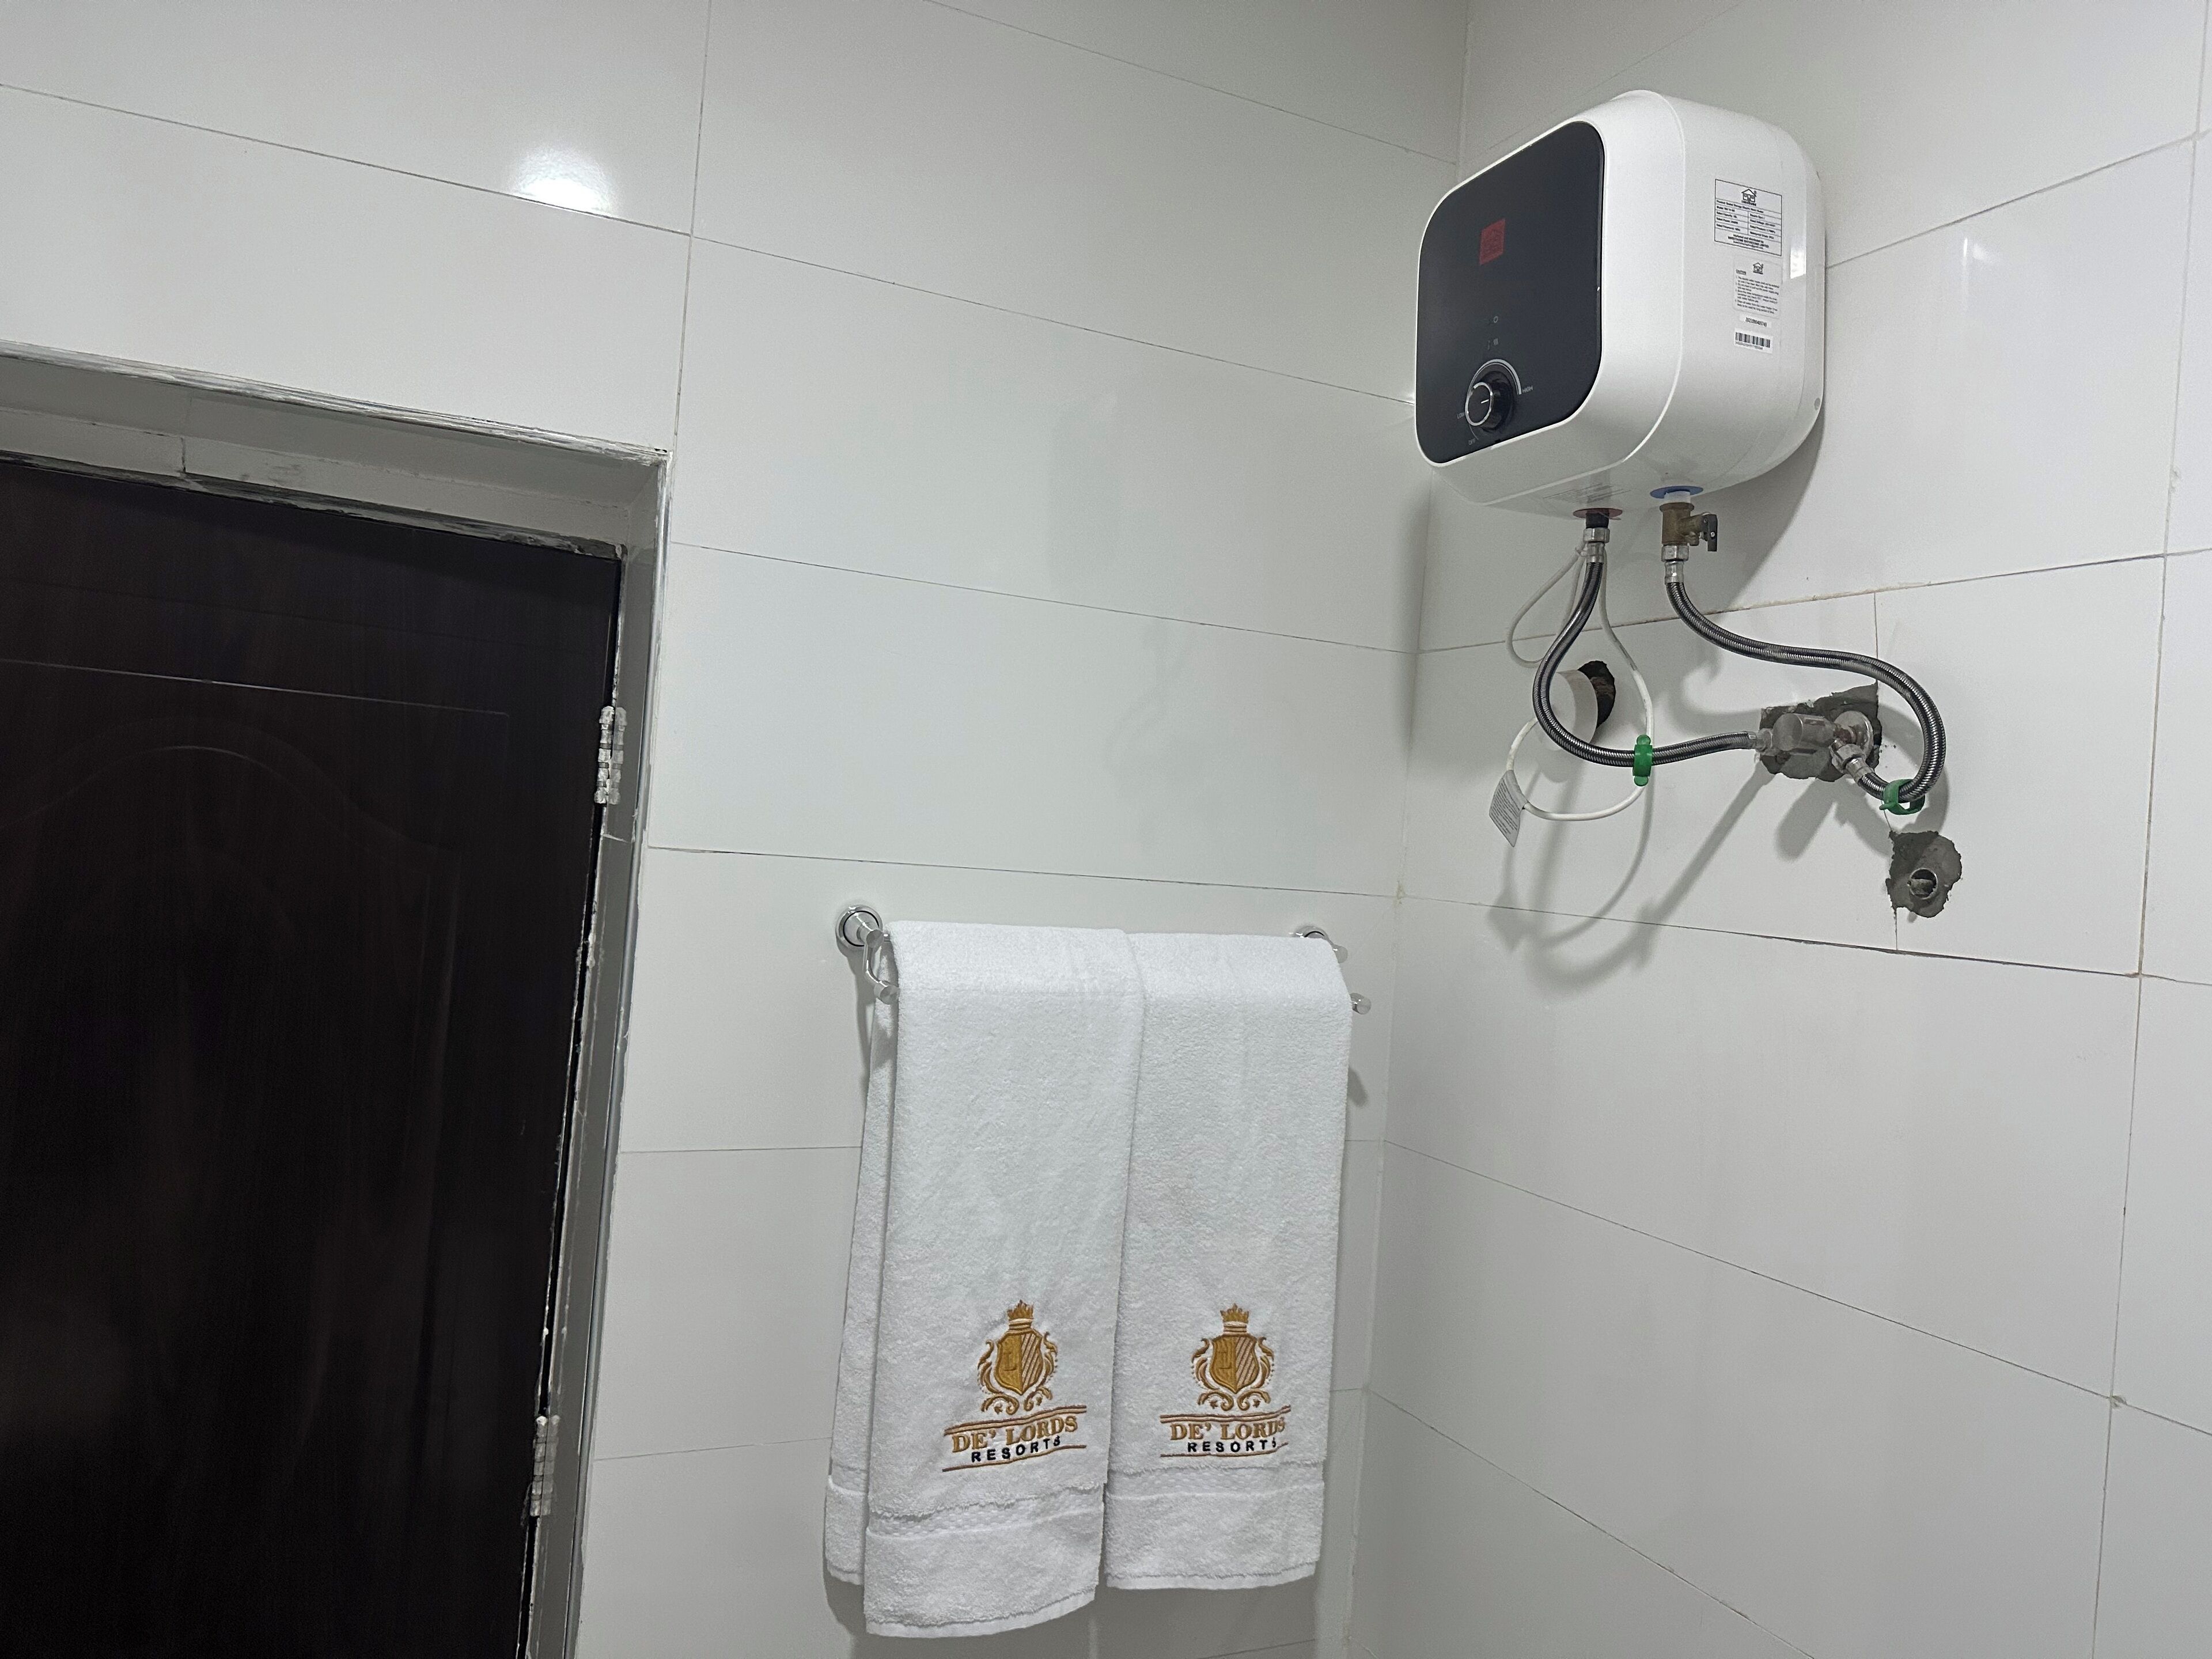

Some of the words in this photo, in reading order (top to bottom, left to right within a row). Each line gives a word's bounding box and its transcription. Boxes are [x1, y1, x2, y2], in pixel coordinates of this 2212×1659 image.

[1006, 1415, 1078, 1445] LORDS
[1220, 1417, 1285, 1440] LORDS
[971, 1435, 1060, 1463] RESORTS
